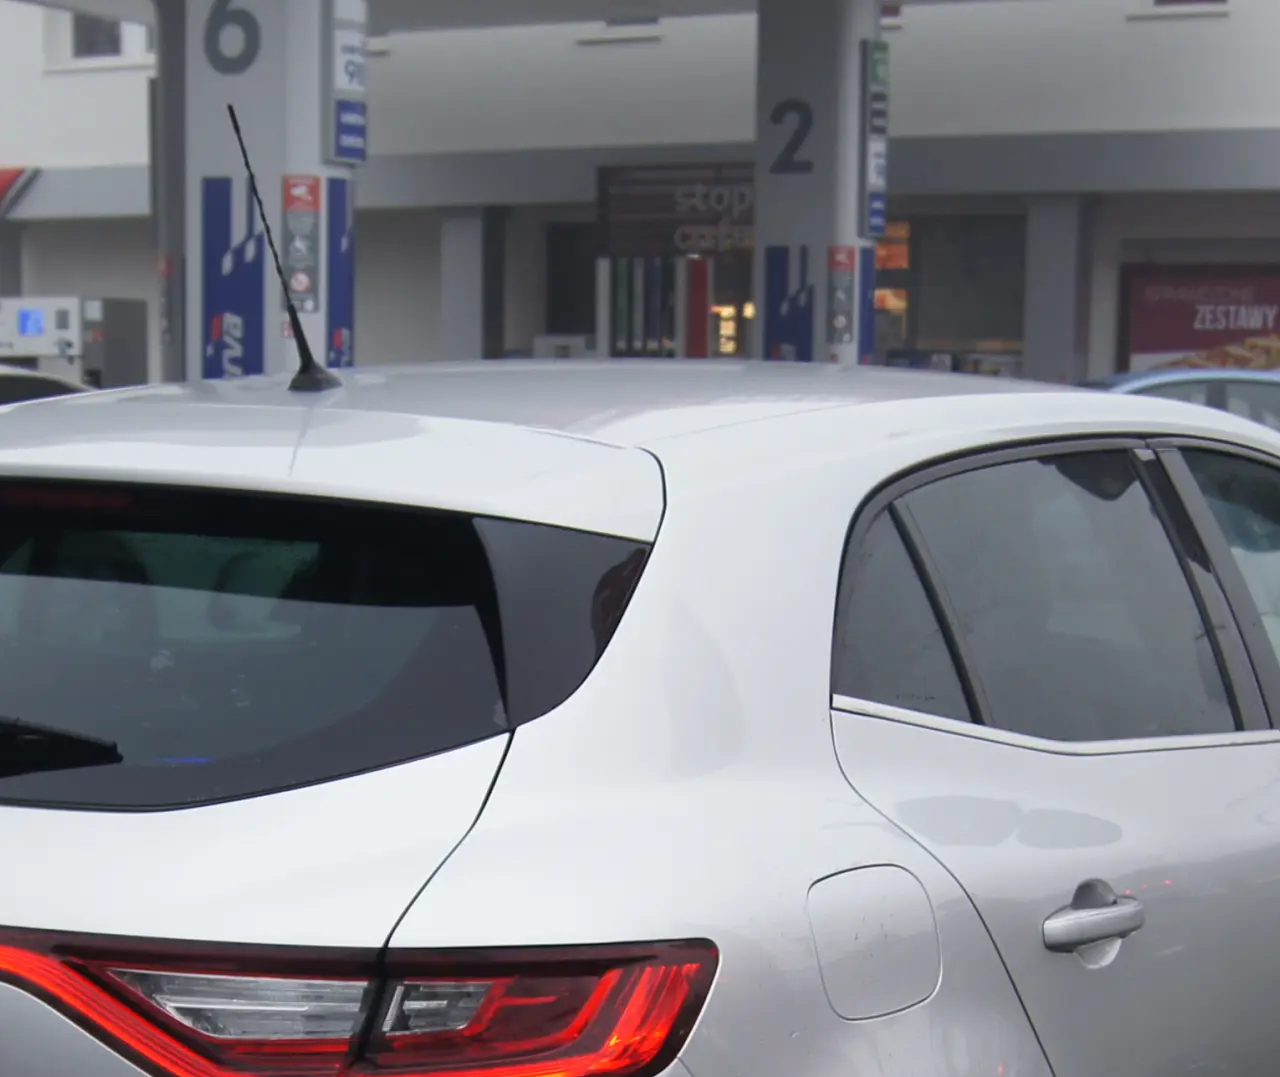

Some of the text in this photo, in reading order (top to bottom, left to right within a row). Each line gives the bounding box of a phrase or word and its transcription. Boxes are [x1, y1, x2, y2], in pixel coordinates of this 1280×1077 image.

[203, 0, 262, 75] 6
[770, 97, 814, 174] 2
[673, 182, 754, 219] stop
[1193, 304, 1279, 330] ZESTAWY
